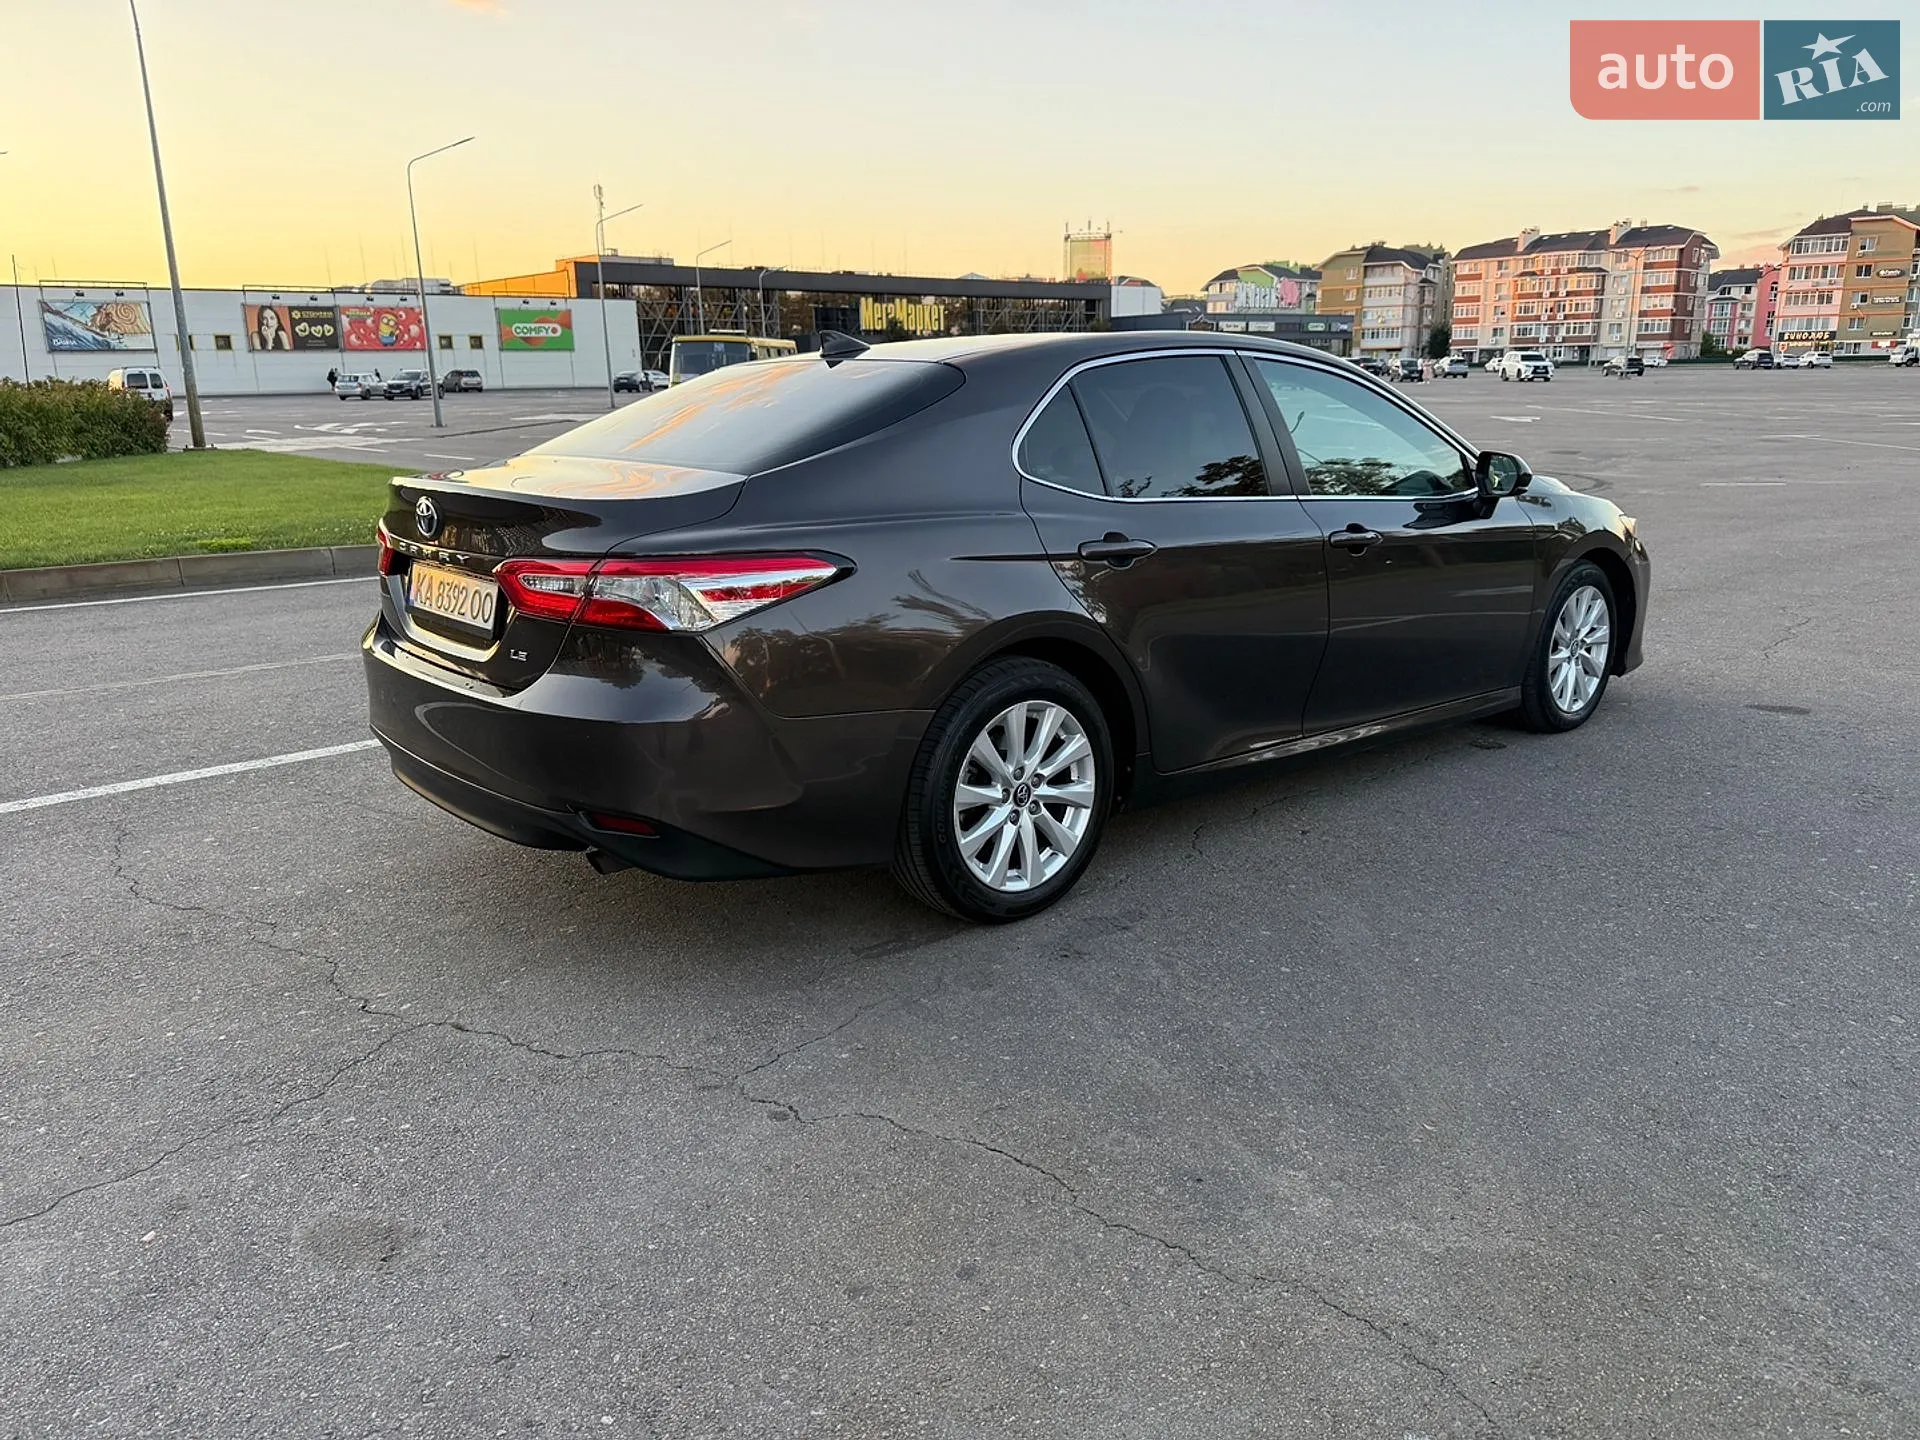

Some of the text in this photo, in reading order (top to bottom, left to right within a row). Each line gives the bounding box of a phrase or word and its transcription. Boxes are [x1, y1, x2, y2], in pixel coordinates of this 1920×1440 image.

[514, 326, 550, 335] COMFY
[414, 571, 433, 607] KA
[436, 580, 468, 616] 8392
[510, 649, 528, 661] LE
